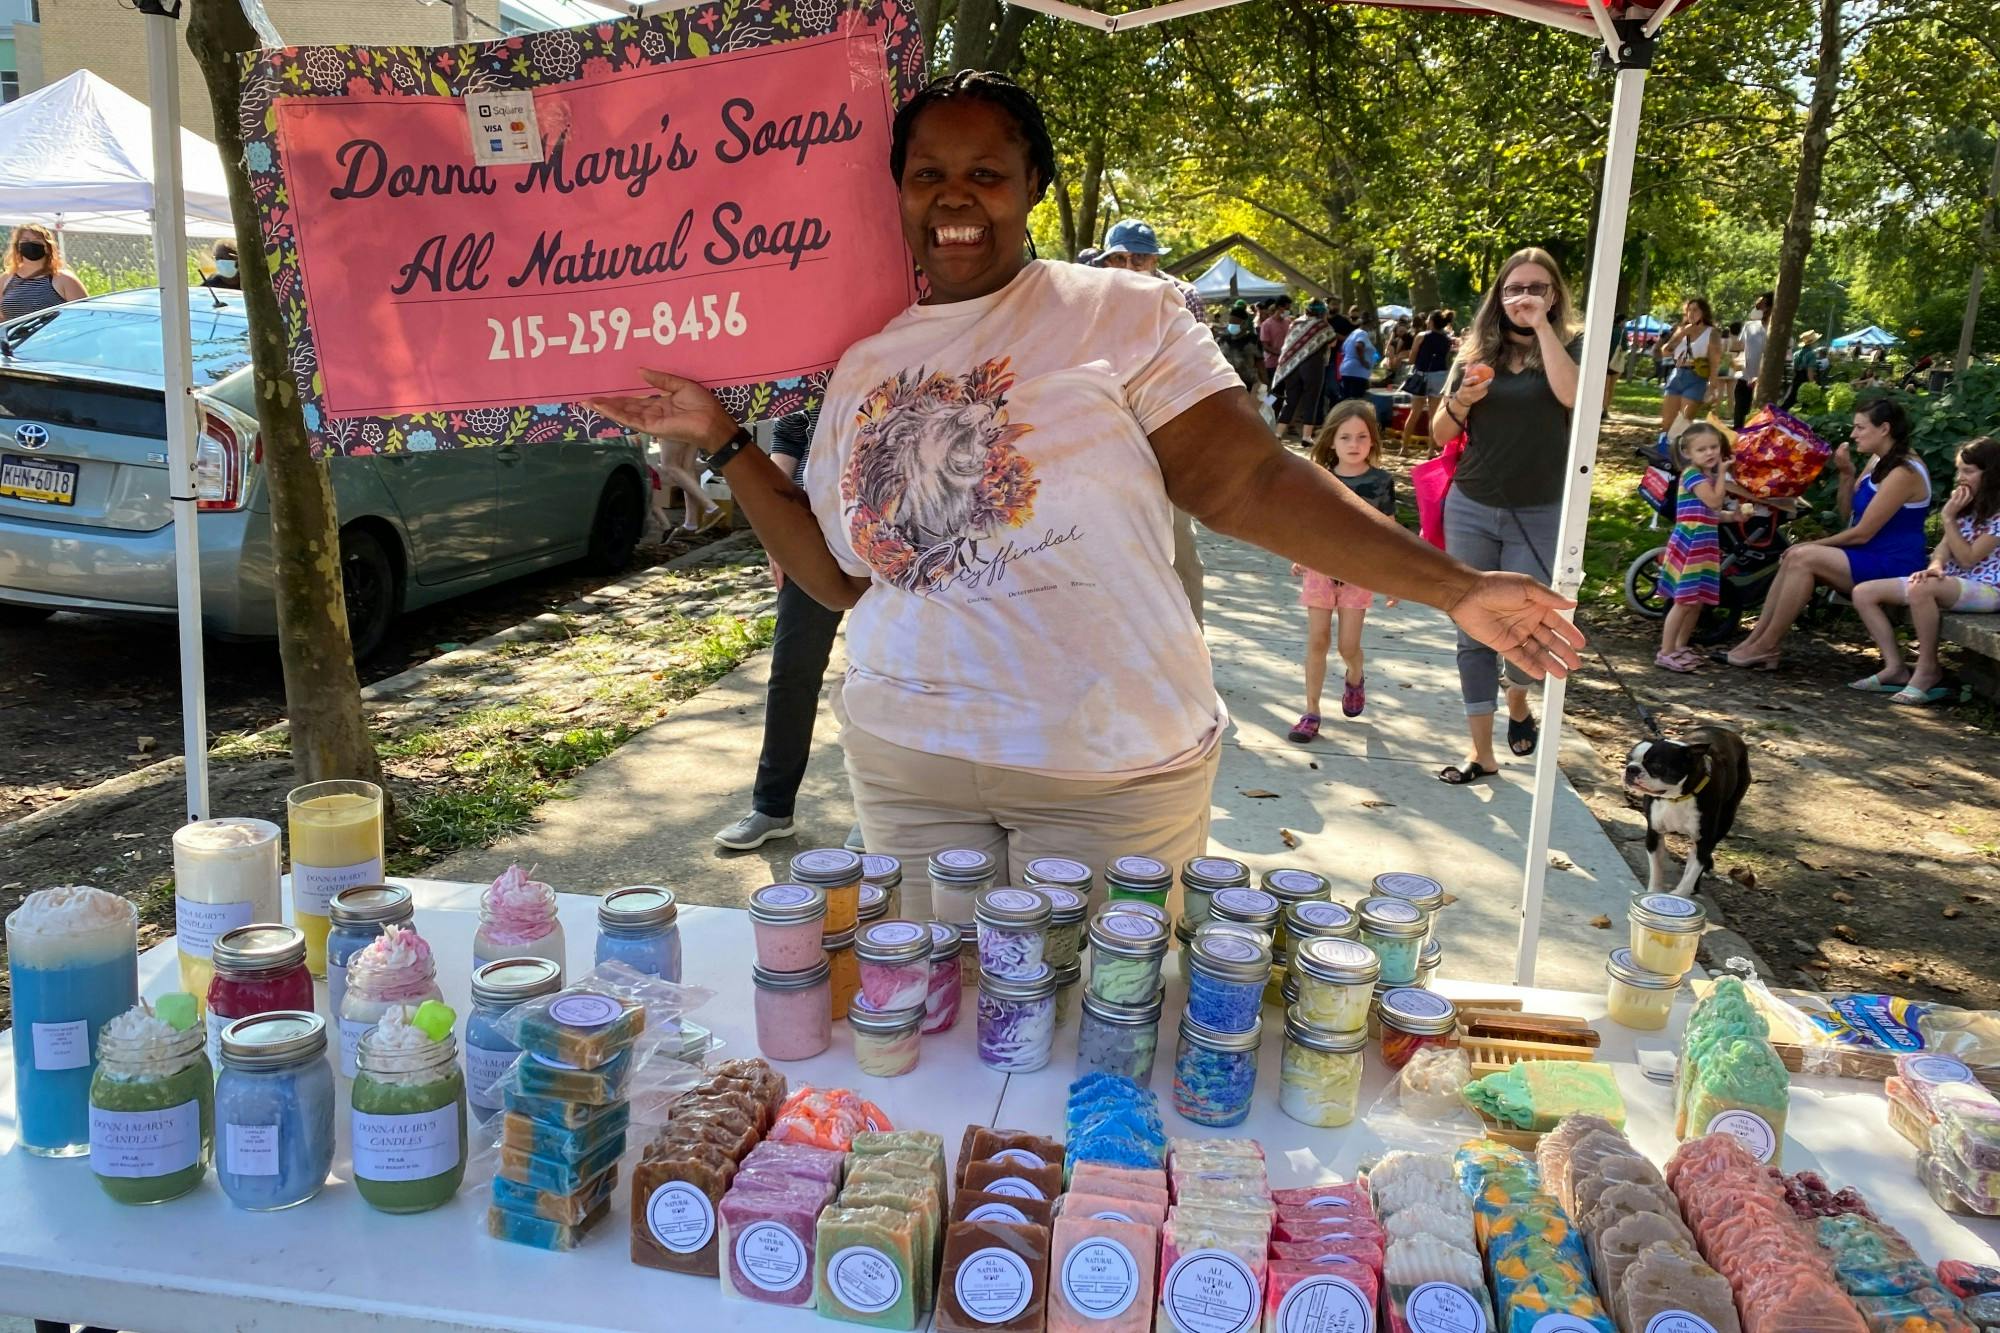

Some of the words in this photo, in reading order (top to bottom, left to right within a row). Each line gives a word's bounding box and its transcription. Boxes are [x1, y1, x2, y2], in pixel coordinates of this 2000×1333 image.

[484, 124, 503, 133] VISA
[330, 139, 497, 200] Donna
[515, 113, 698, 198] Mary's
[715, 98, 863, 166] Soaps
[391, 231, 495, 295] All
[508, 208, 694, 287] Natural
[704, 201, 831, 271] Soap
[487, 291, 748, 361] 215-259-8456
[1008, 584, 1058, 598] Determination
[1863, 1004, 1896, 1027] PAPER
[94, 1119, 129, 1132] DONNA
[359, 1121, 395, 1134] DONNA
[104, 1134, 159, 1144] CANDLES
[369, 1135, 423, 1146] CANDLES
[1084, 1257, 1113, 1265] NATURAL
[977, 1266, 1007, 1274] NATURAL
[1208, 1267, 1224, 1276] ALL
[1195, 1273, 1234, 1290] NATURAL
[1202, 1286, 1224, 1298] SOAP
